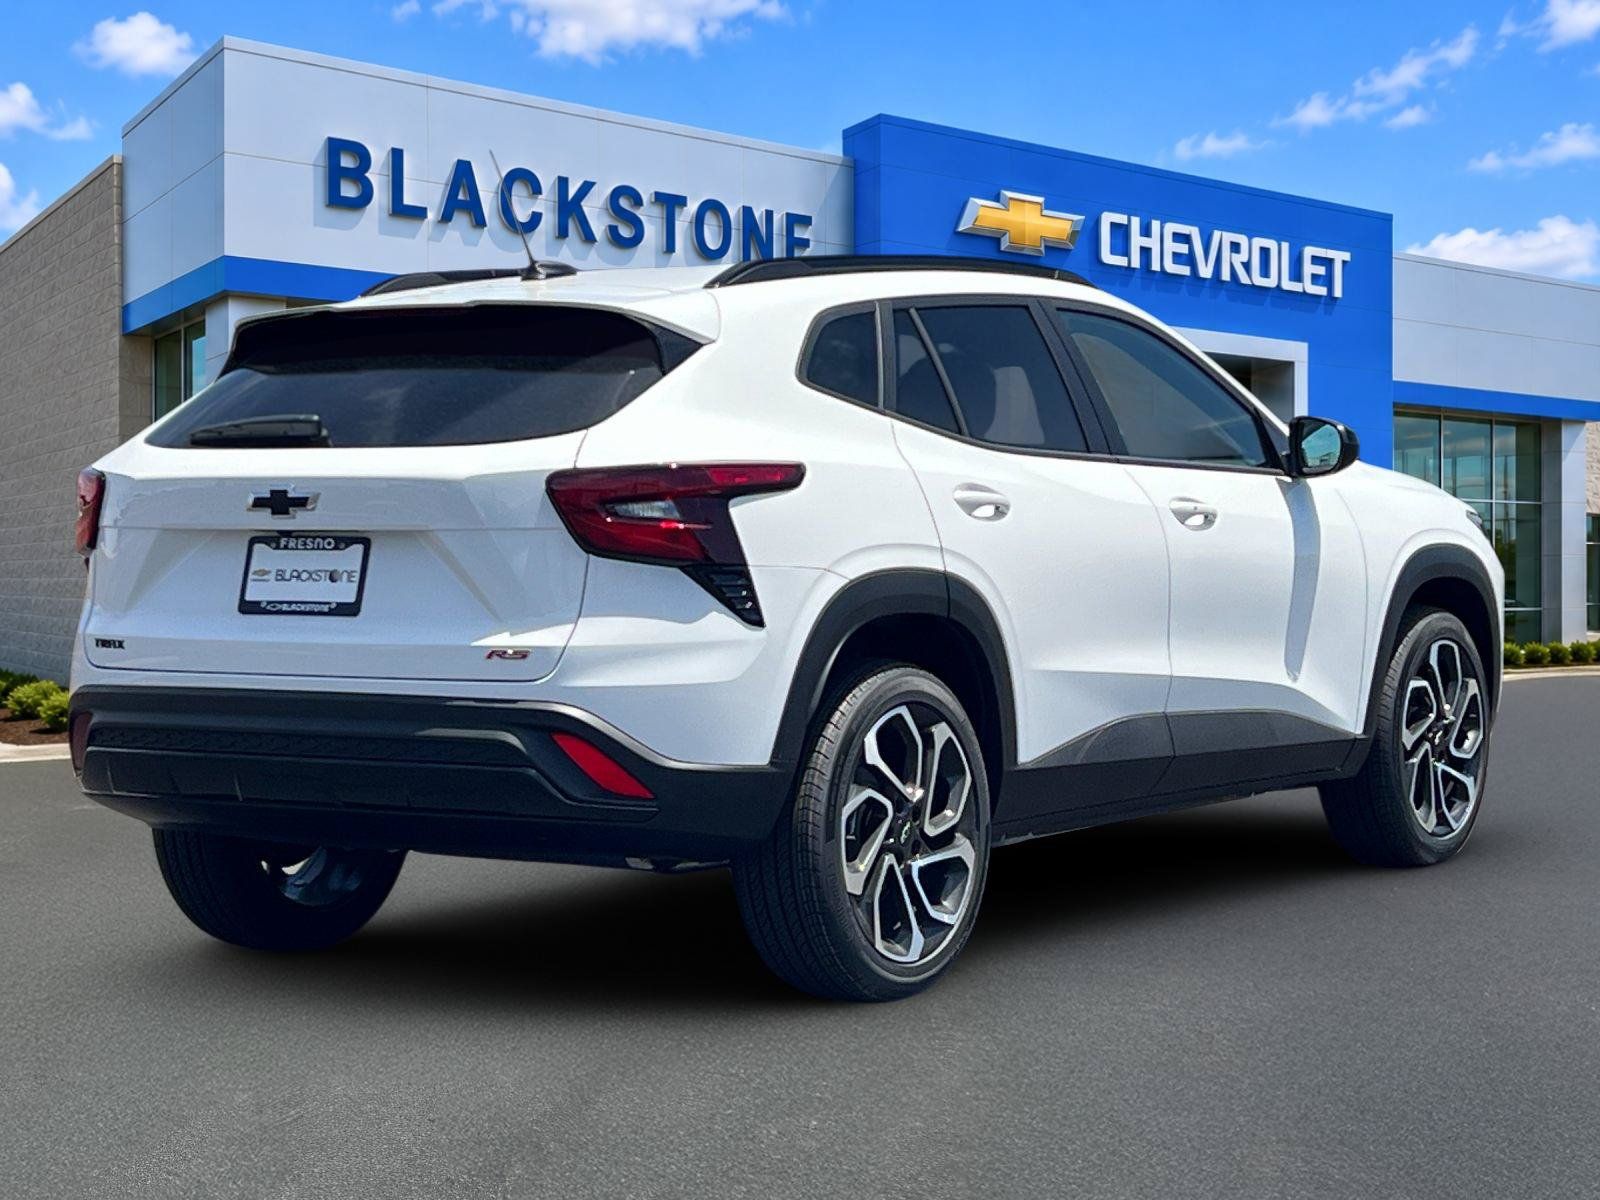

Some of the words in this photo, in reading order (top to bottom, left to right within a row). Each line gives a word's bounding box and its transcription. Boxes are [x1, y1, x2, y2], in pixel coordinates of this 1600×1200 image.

[324, 136, 813, 261] BLACKSTONE
[1101, 211, 1351, 298] CHEVROLET
[280, 537, 335, 549] FRESNO
[275, 568, 358, 583] BLACKSTONE
[486, 649, 530, 660] RS
